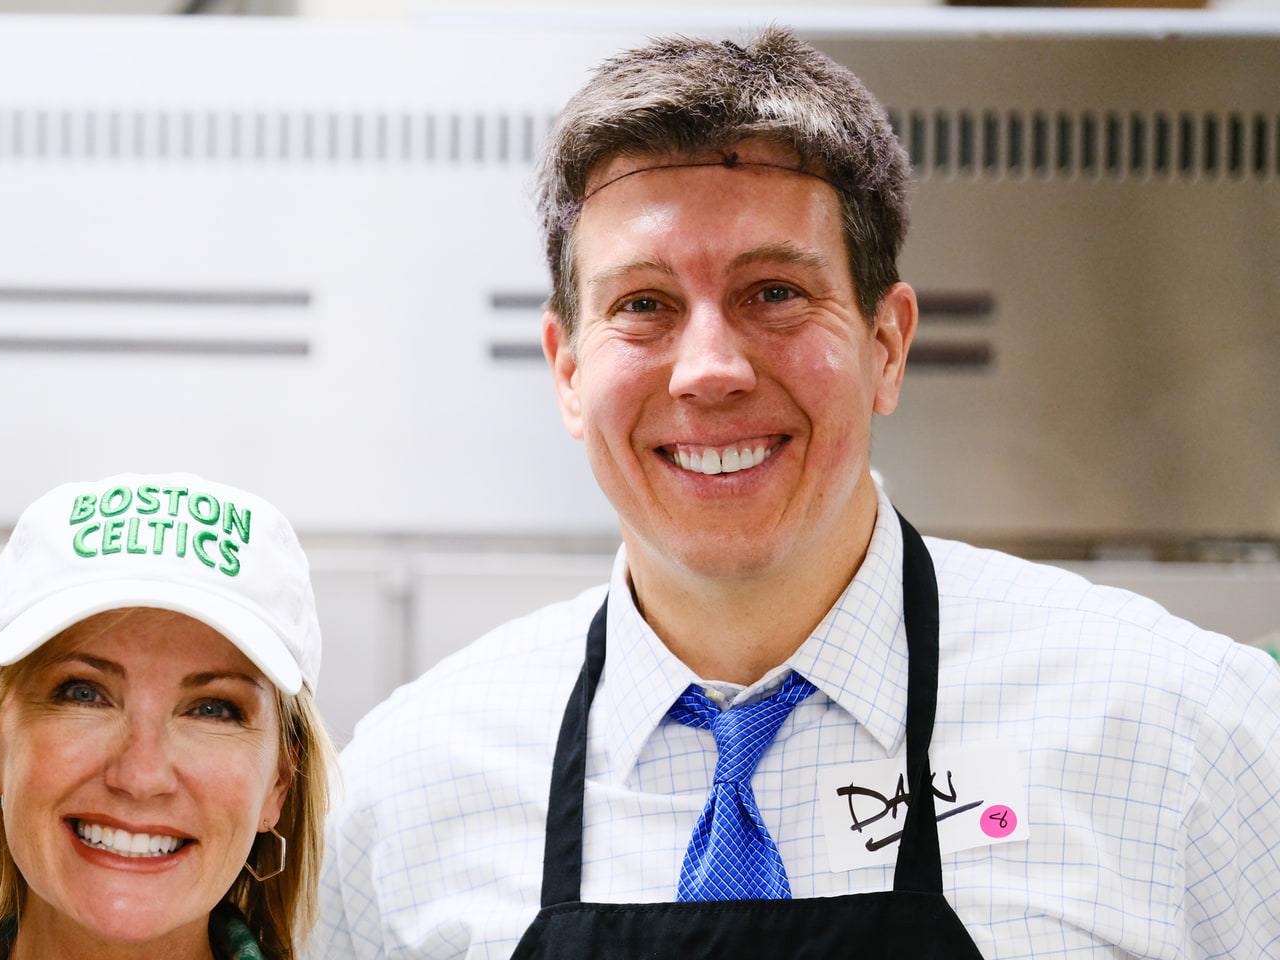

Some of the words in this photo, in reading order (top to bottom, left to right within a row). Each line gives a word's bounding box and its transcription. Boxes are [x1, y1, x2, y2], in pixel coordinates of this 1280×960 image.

[69, 484, 251, 544] BOSTON
[73, 517, 241, 577] CELTICS
[836, 770, 956, 833] DAN
